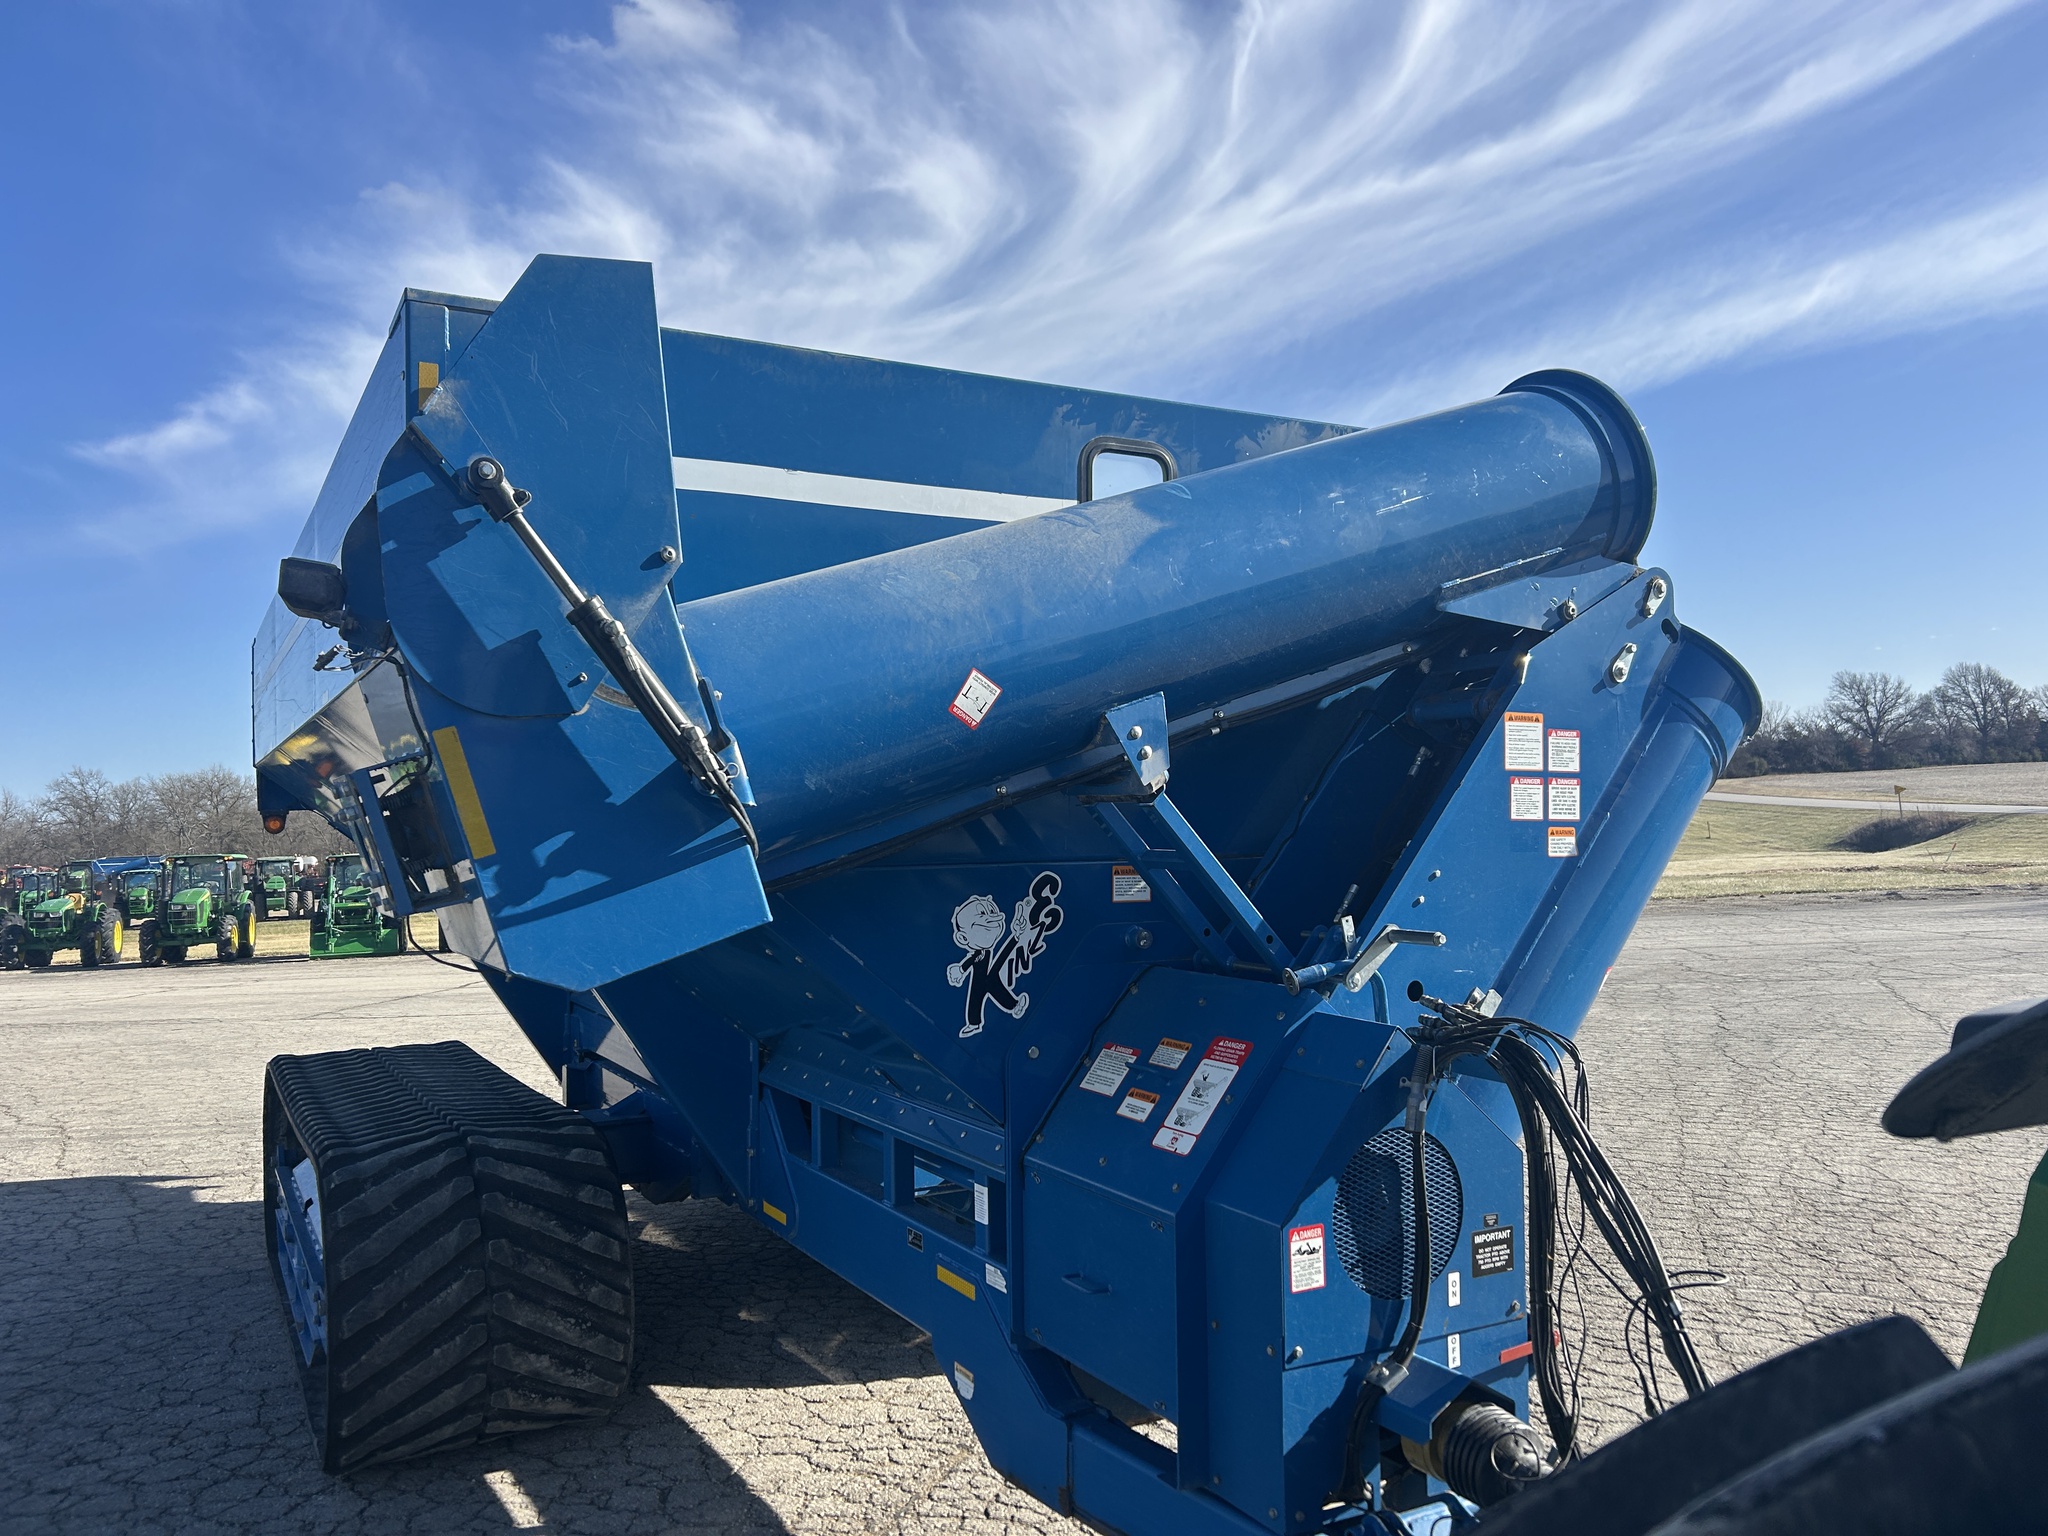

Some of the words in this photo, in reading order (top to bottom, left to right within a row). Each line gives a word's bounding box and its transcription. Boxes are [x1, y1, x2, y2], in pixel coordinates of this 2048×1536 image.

[952, 706, 973, 724] DANGER
[955, 872, 1062, 1032] KINZE
[1115, 1046, 1133, 1054] DANGER
[1223, 1040, 1246, 1050] DANGER
[1299, 1227, 1322, 1240] DANGER
[1474, 1229, 1511, 1244] IMPORTANT
[1451, 1280, 1457, 1298] ON
